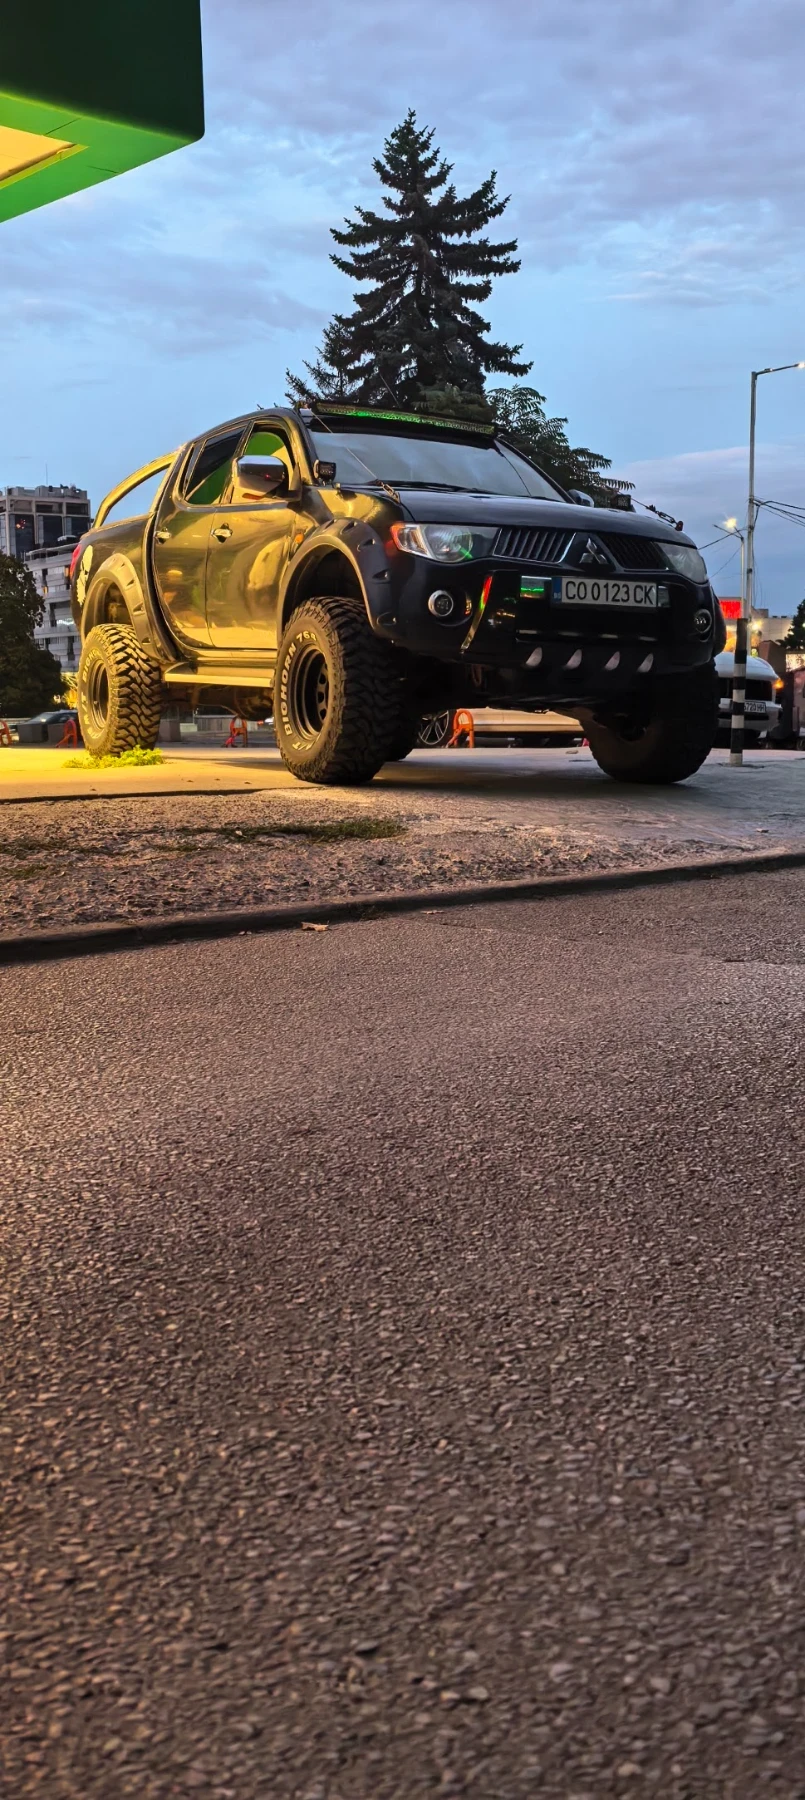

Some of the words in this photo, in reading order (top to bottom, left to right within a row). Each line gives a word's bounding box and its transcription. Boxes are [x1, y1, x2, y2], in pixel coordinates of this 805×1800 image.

[565, 580, 588, 601] CO
[591, 582, 630, 603] 0123
[633, 584, 654, 605] CK
[280, 642, 298, 736] BIGHORN
